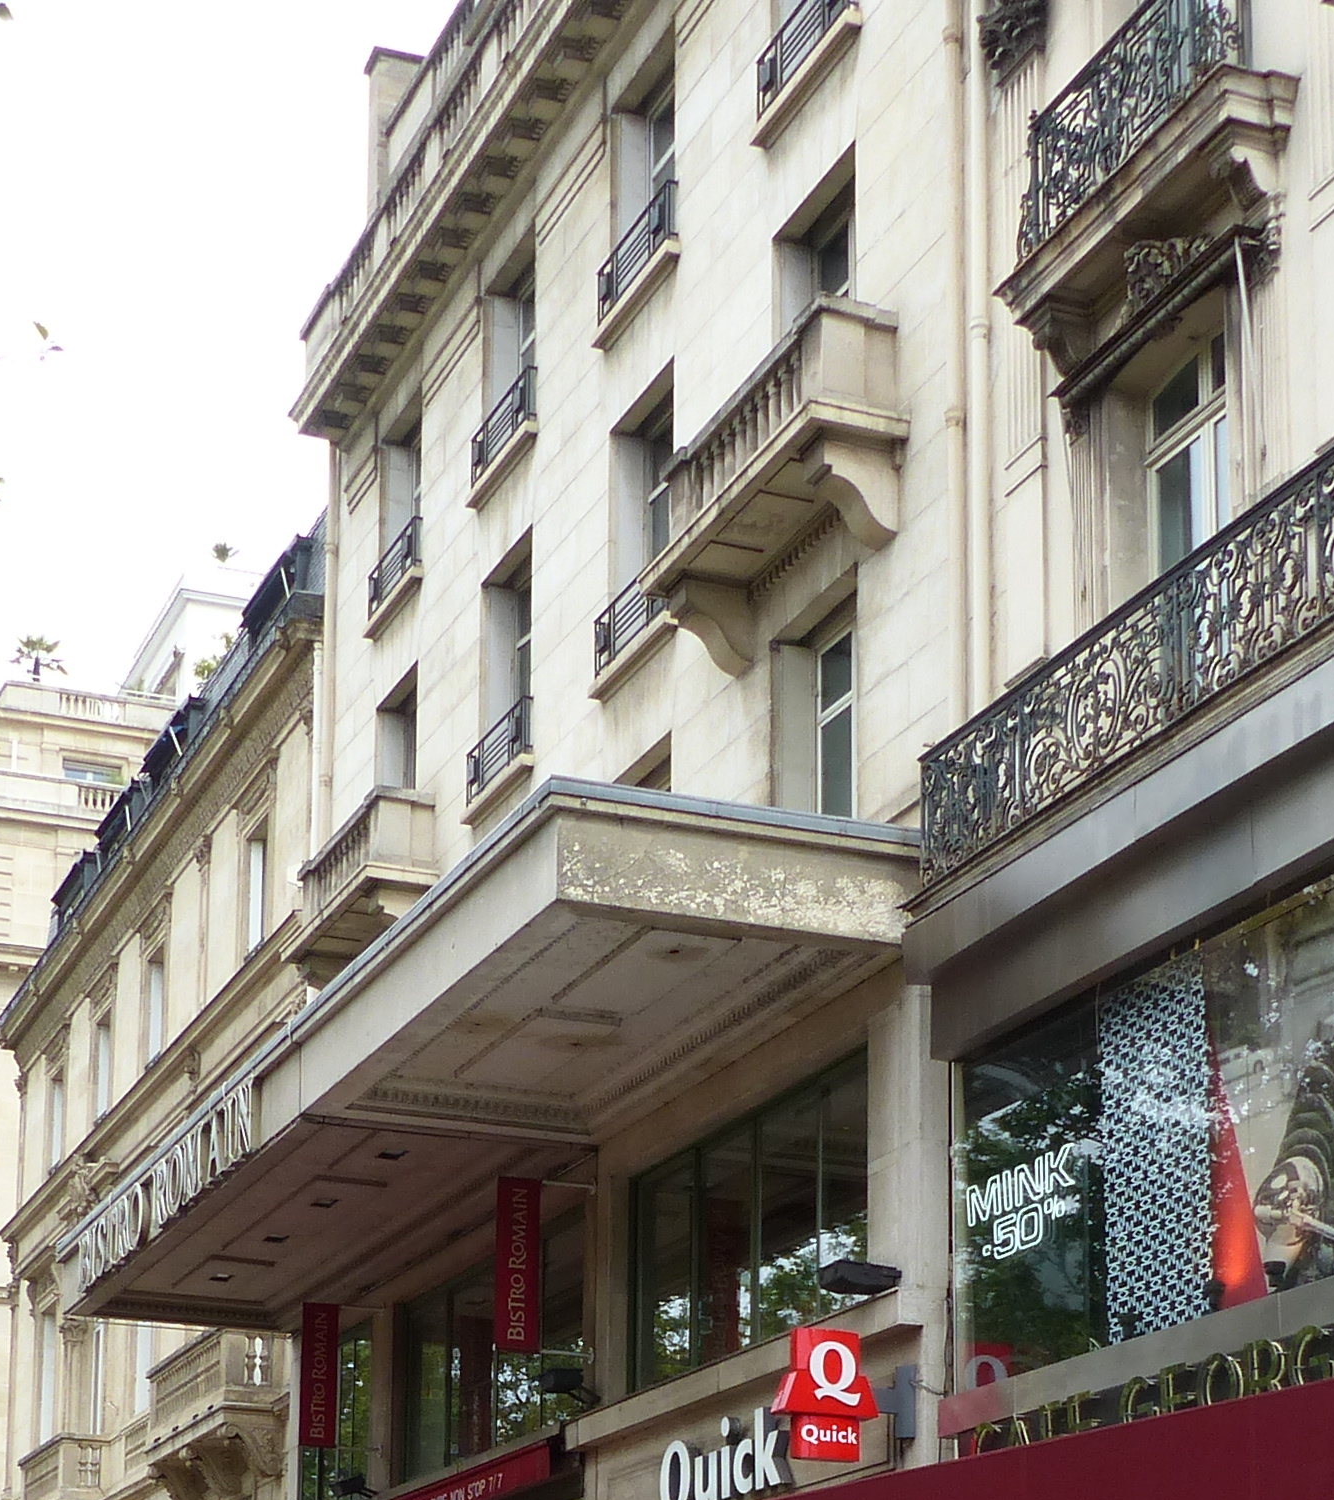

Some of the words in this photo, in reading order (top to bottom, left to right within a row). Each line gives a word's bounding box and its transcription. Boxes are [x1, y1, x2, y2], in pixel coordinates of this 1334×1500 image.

[78, 1182, 143, 1295] BISTRO
[151, 1075, 254, 1231] ROMAIN
[967, 1142, 1075, 1228] MINK
[508, 1187, 528, 1271] ROMAIN
[507, 1274, 526, 1342] BISTRO
[312, 1312, 330, 1383] ROMAIN
[809, 1340, 862, 1407] Q
[309, 1384, 326, 1440] BISTRO
[800, 1423, 858, 1446] Quick
[487, 1472, 503, 1494] 7/7
